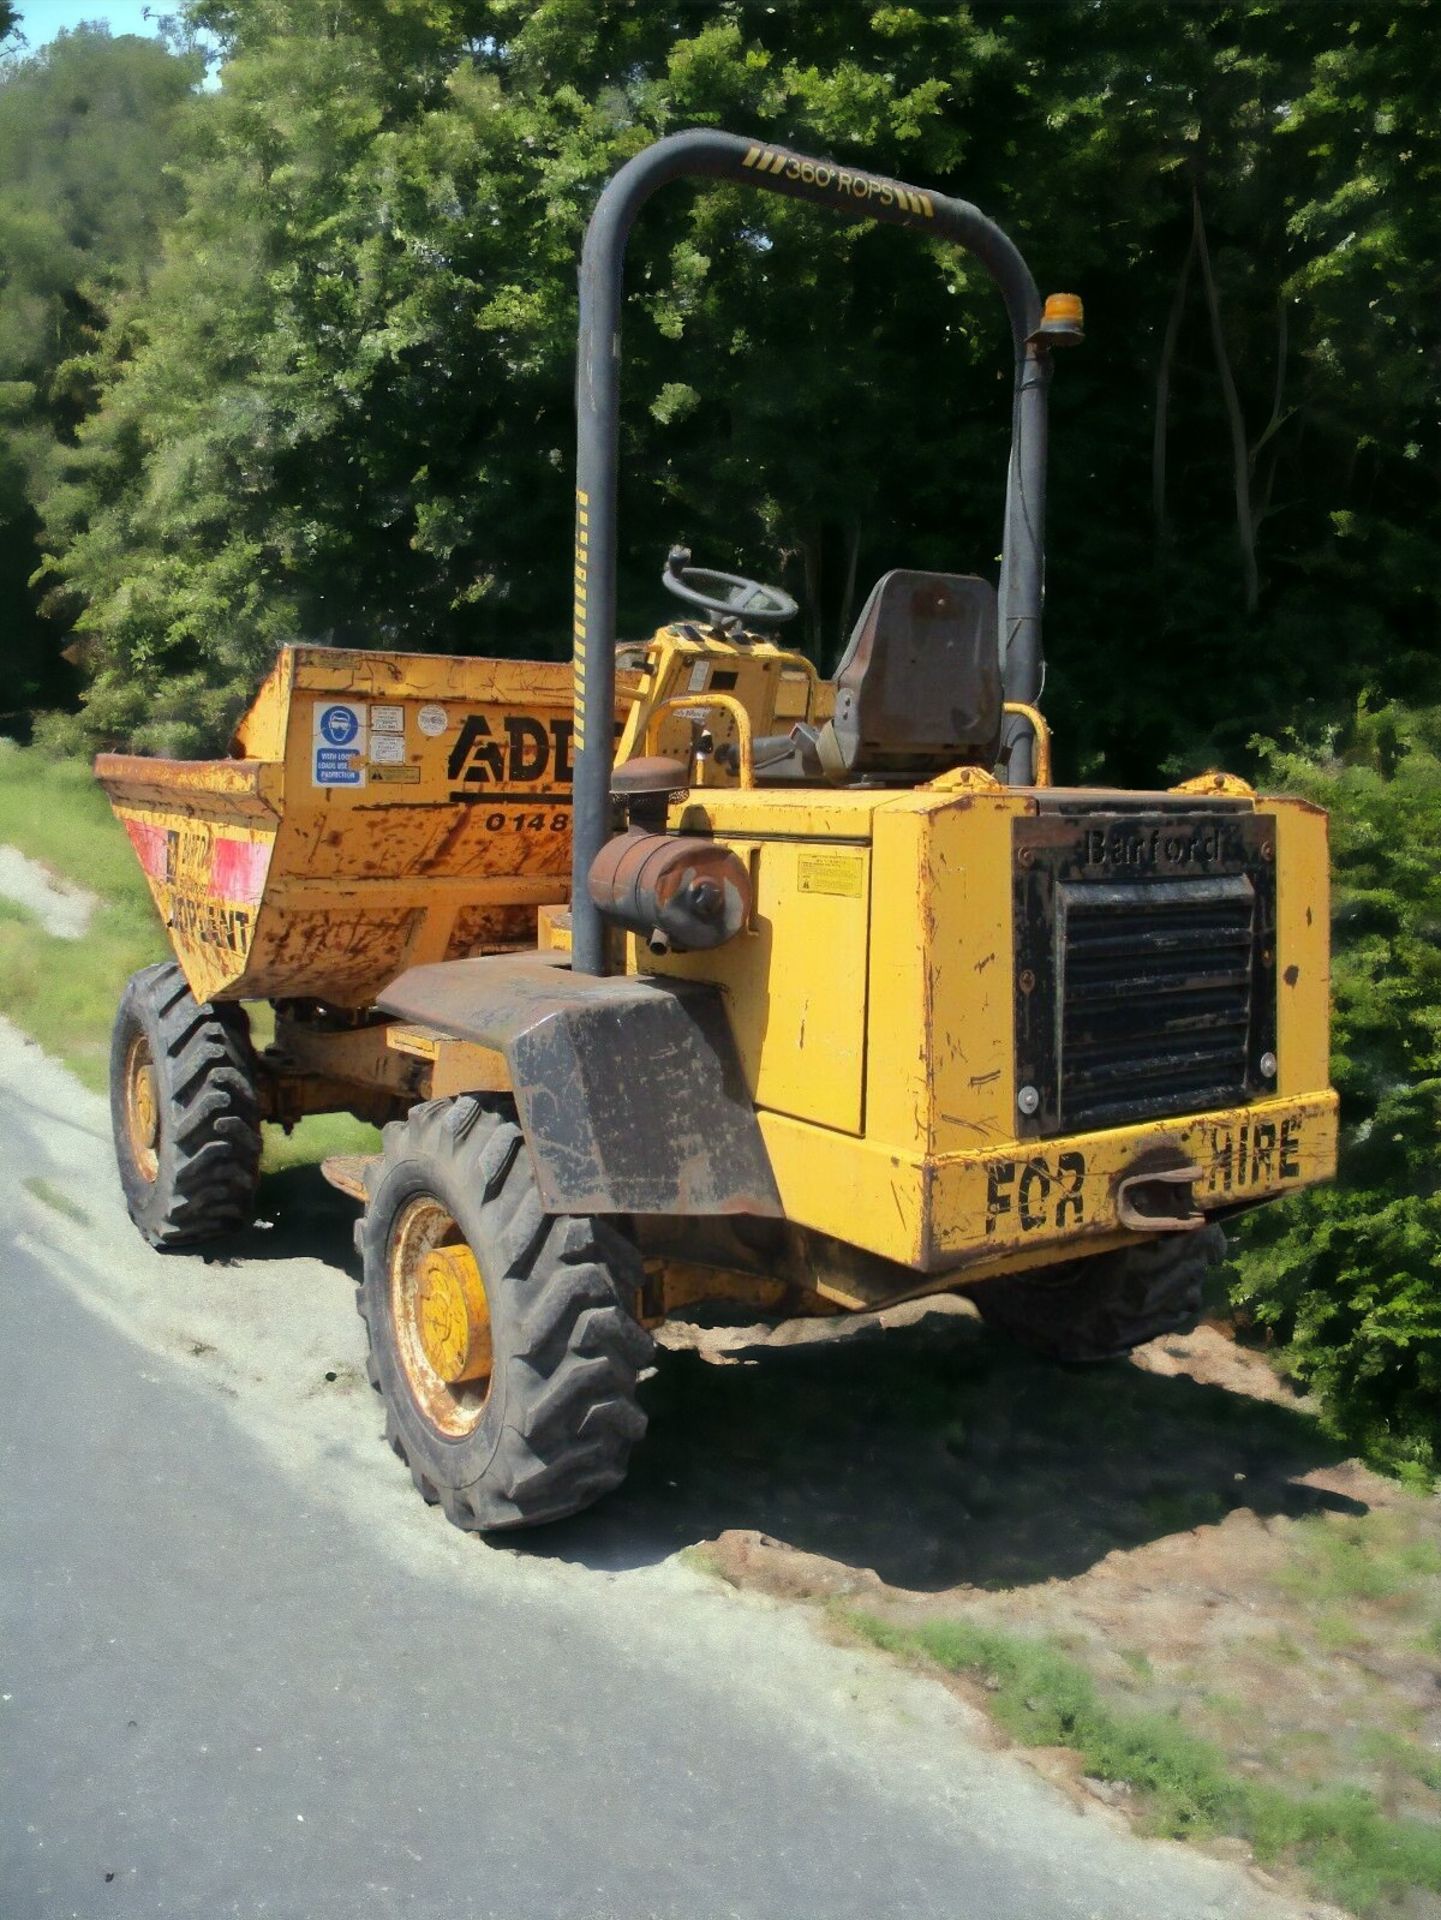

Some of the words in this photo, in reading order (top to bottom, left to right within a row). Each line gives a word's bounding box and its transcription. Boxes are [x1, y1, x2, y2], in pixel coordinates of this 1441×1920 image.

[837, 172, 894, 205] ROPS
[1086, 828, 1222, 865] Barford
[985, 1151, 1086, 1235] FOR
[1207, 1117, 1301, 1192] HIRE
